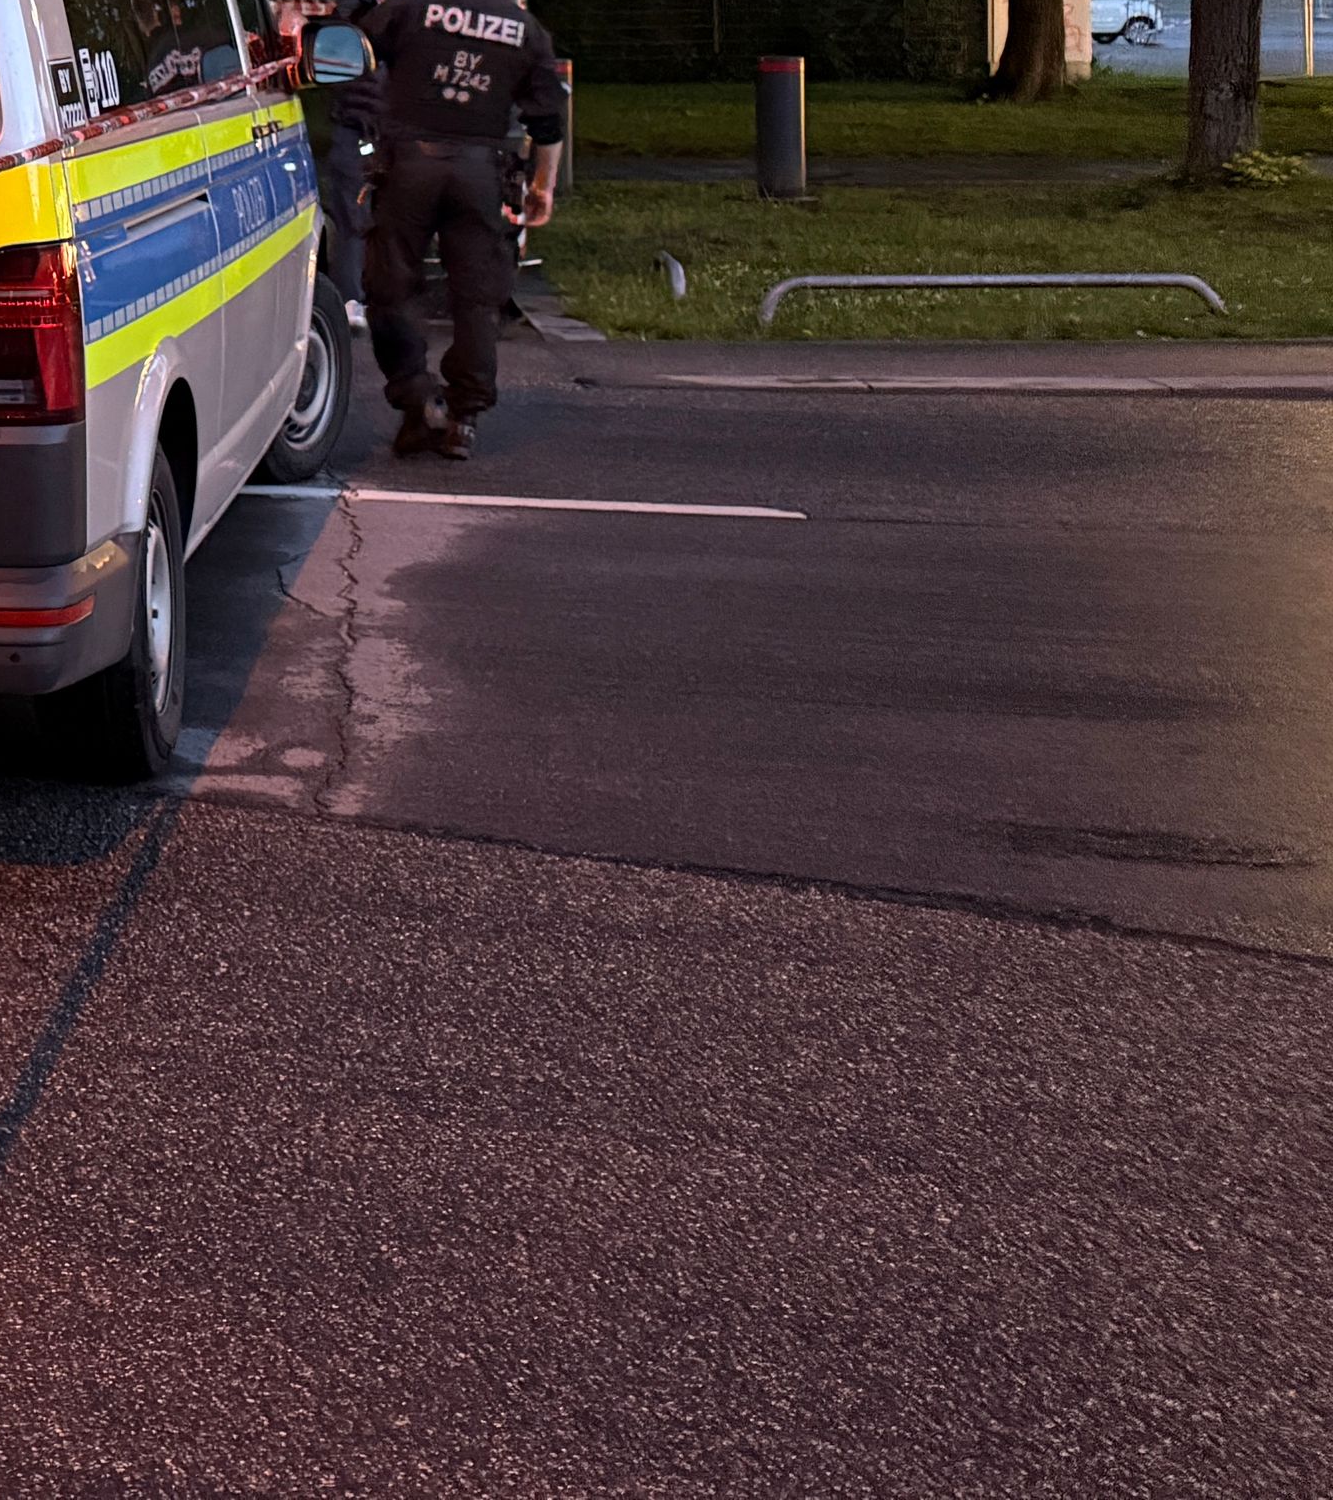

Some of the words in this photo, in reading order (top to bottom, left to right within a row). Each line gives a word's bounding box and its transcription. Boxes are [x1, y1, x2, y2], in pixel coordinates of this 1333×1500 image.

[425, 3, 525, 47] POLIZEI
[454, 50, 482, 70] BY
[58, 68, 72, 94] BY
